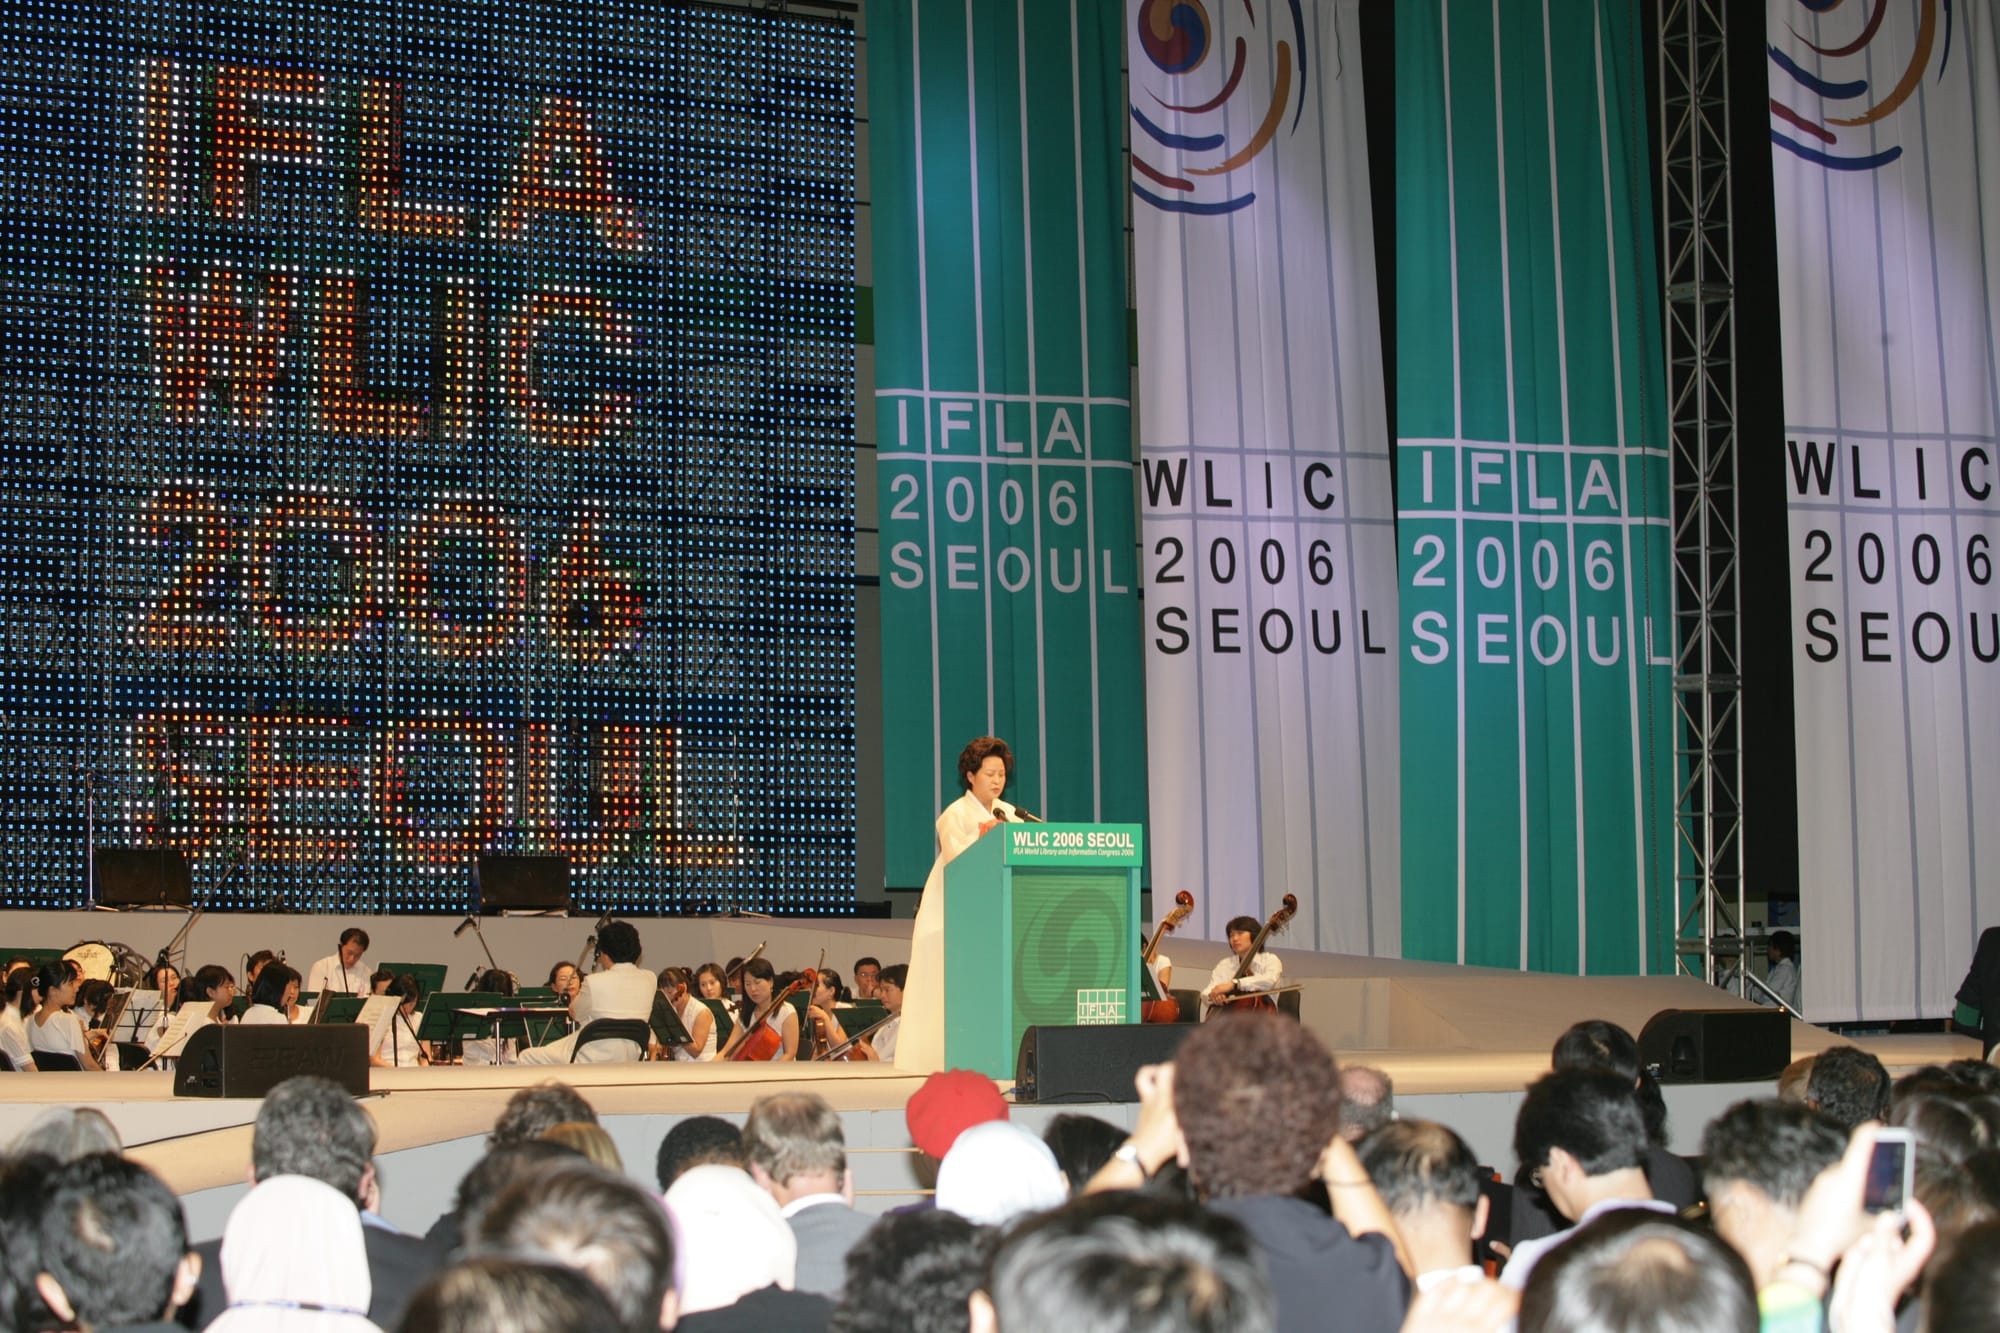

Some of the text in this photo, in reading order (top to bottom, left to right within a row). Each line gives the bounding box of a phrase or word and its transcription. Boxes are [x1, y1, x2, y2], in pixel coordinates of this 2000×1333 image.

[134, 57, 651, 252] IFLA
[134, 257, 634, 446] WLIC
[897, 398, 1083, 454] IFLA
[1142, 457, 1336, 511] WLIC
[1421, 449, 1619, 511] IFLA
[1787, 440, 1993, 501] WLIC
[890, 473, 1078, 526] 2006
[128, 480, 643, 661] 2006
[889, 541, 1129, 595] SEOUL
[1154, 536, 1335, 586] 2006
[1412, 534, 1616, 591] 2006
[1804, 529, 1992, 586] 2006
[1155, 606, 1387, 655] SEOUL
[1410, 610, 1673, 666] SEOUL
[1805, 607, 2000, 664] SEOU
[124, 702, 746, 874] SEOUL
[1013, 831, 1135, 848] WLIC 2006 SEOUL
[1024, 848, 1039, 856] World
[1040, 848, 1057, 857] Library
[1057, 848, 1068, 856] and
[1068, 848, 1098, 857] Information
[1098, 848, 1121, 858] Congress
[1081, 1004, 1116, 1017] IFLA
